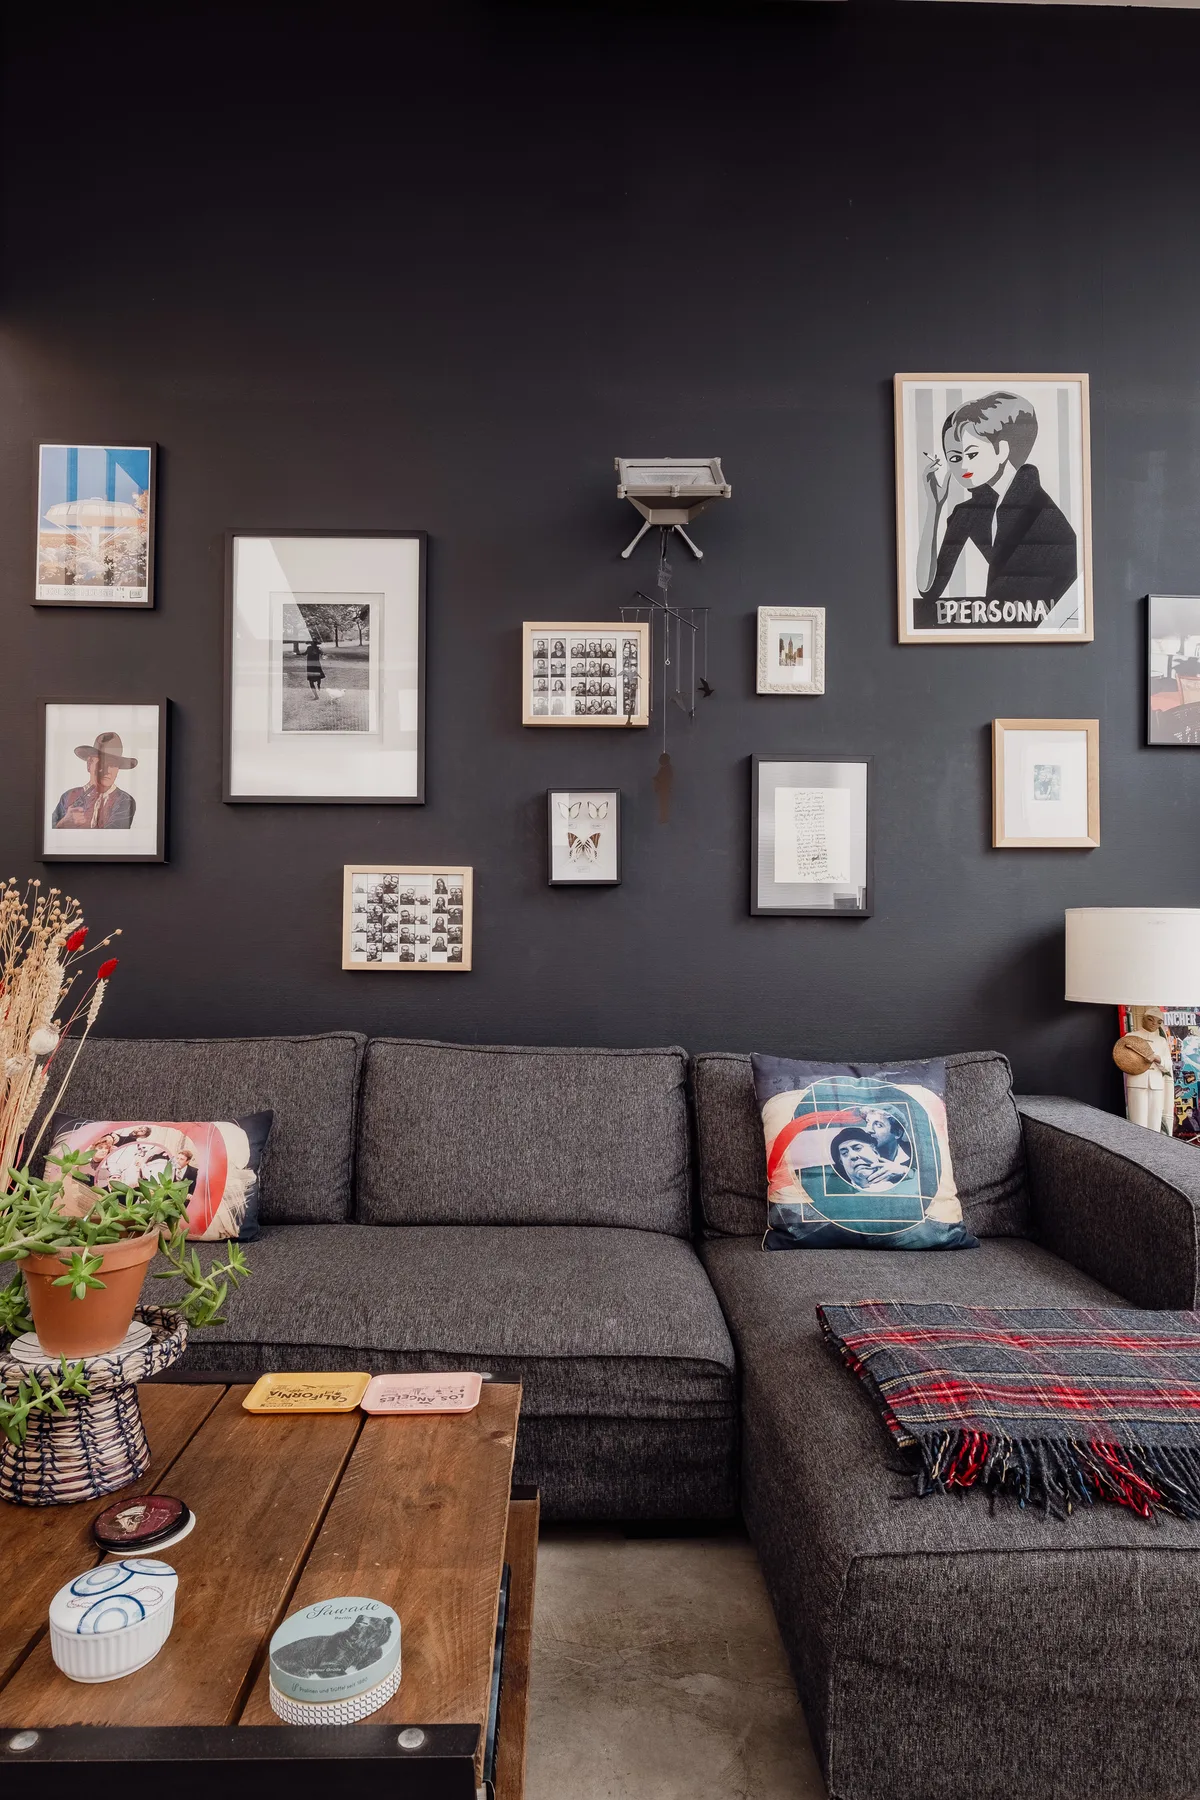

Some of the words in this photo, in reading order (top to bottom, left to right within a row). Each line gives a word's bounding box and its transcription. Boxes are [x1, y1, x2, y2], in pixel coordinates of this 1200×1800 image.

[944, 599, 1049, 624] PERSONA
[1164, 1011, 1197, 1026] INCHER
[269, 1390, 348, 1403] CALIFORNIA
[379, 1394, 435, 1404] ANGELES
[441, 1393, 464, 1402] LOS
[306, 1602, 380, 1619] Sawade
